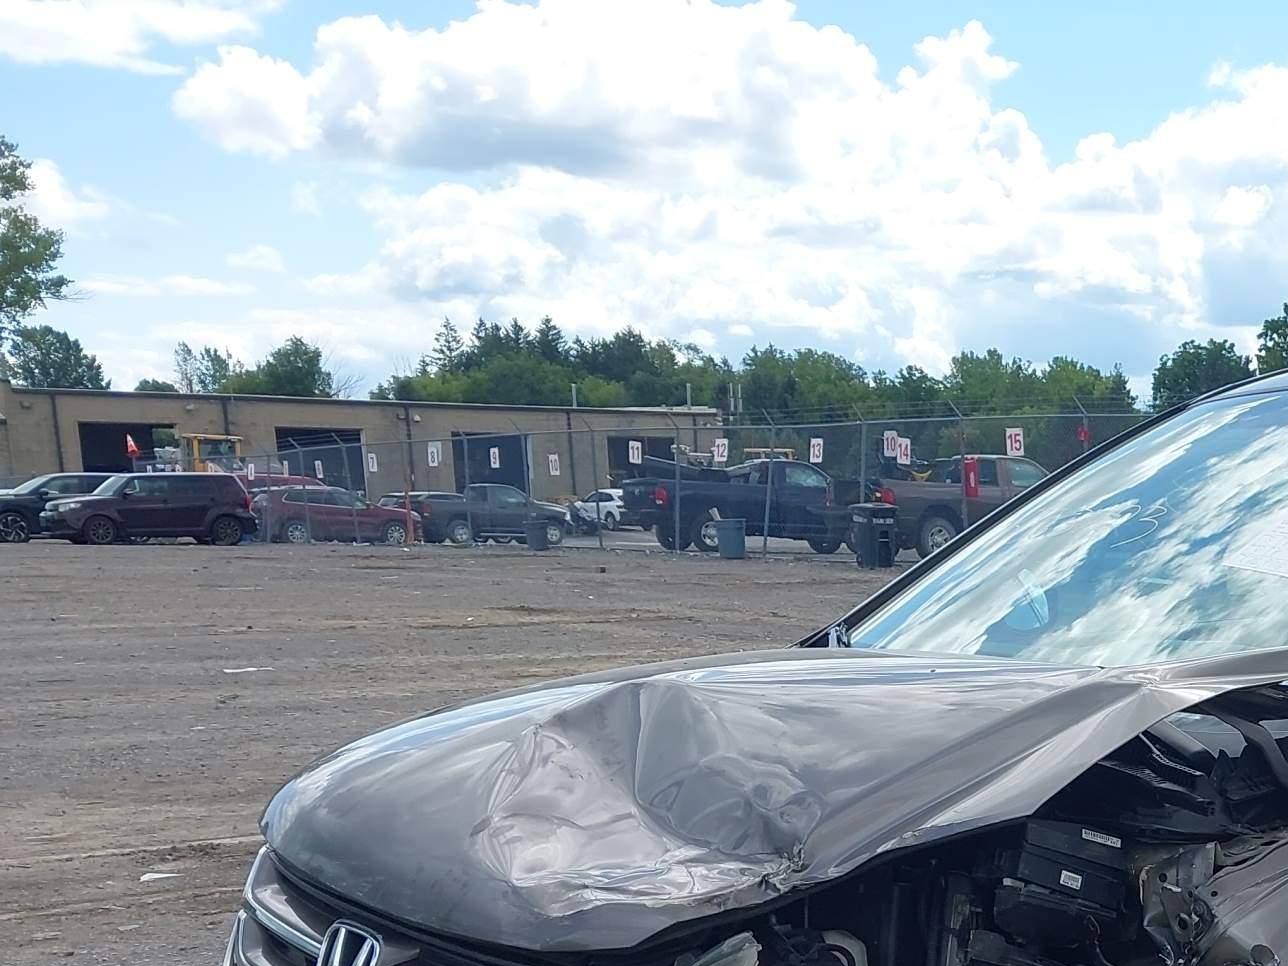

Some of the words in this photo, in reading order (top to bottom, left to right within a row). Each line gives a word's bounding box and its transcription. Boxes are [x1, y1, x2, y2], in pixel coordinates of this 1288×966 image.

[885, 438, 896, 453] 10
[1007, 432, 1022, 452] 15
[630, 445, 641, 460] 11
[715, 443, 727, 458] 12
[811, 443, 821, 459] 13
[898, 443, 909, 460] 14
[550, 458, 559, 472] 10
